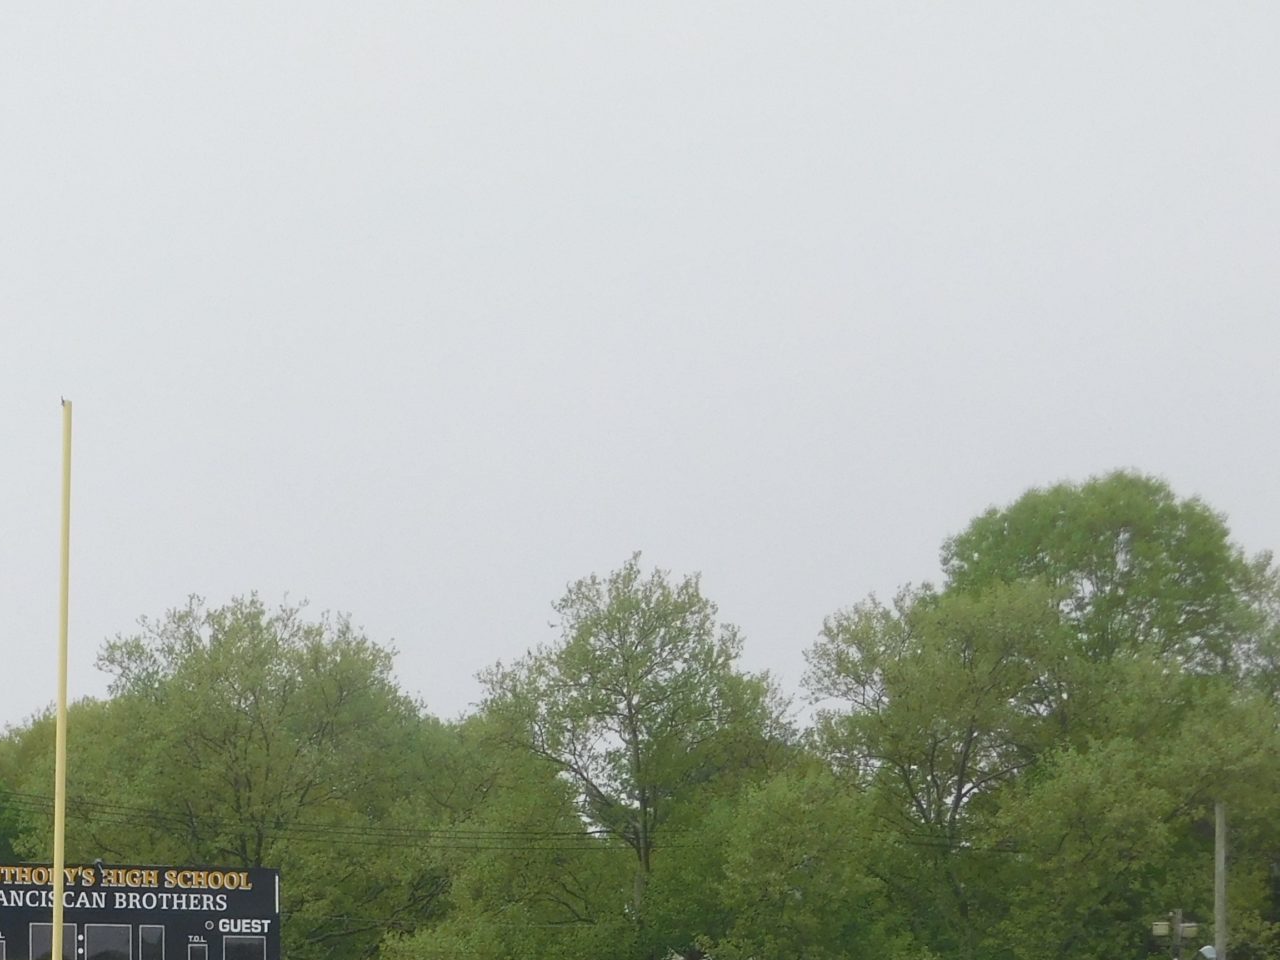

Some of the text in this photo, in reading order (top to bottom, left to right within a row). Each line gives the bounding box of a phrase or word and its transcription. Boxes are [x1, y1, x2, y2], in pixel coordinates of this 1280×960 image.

[100, 868, 159, 888] HIGH
[164, 870, 253, 890] SCHOOL
[114, 892, 228, 911] BROTHERS
[219, 919, 271, 933] GUEST
